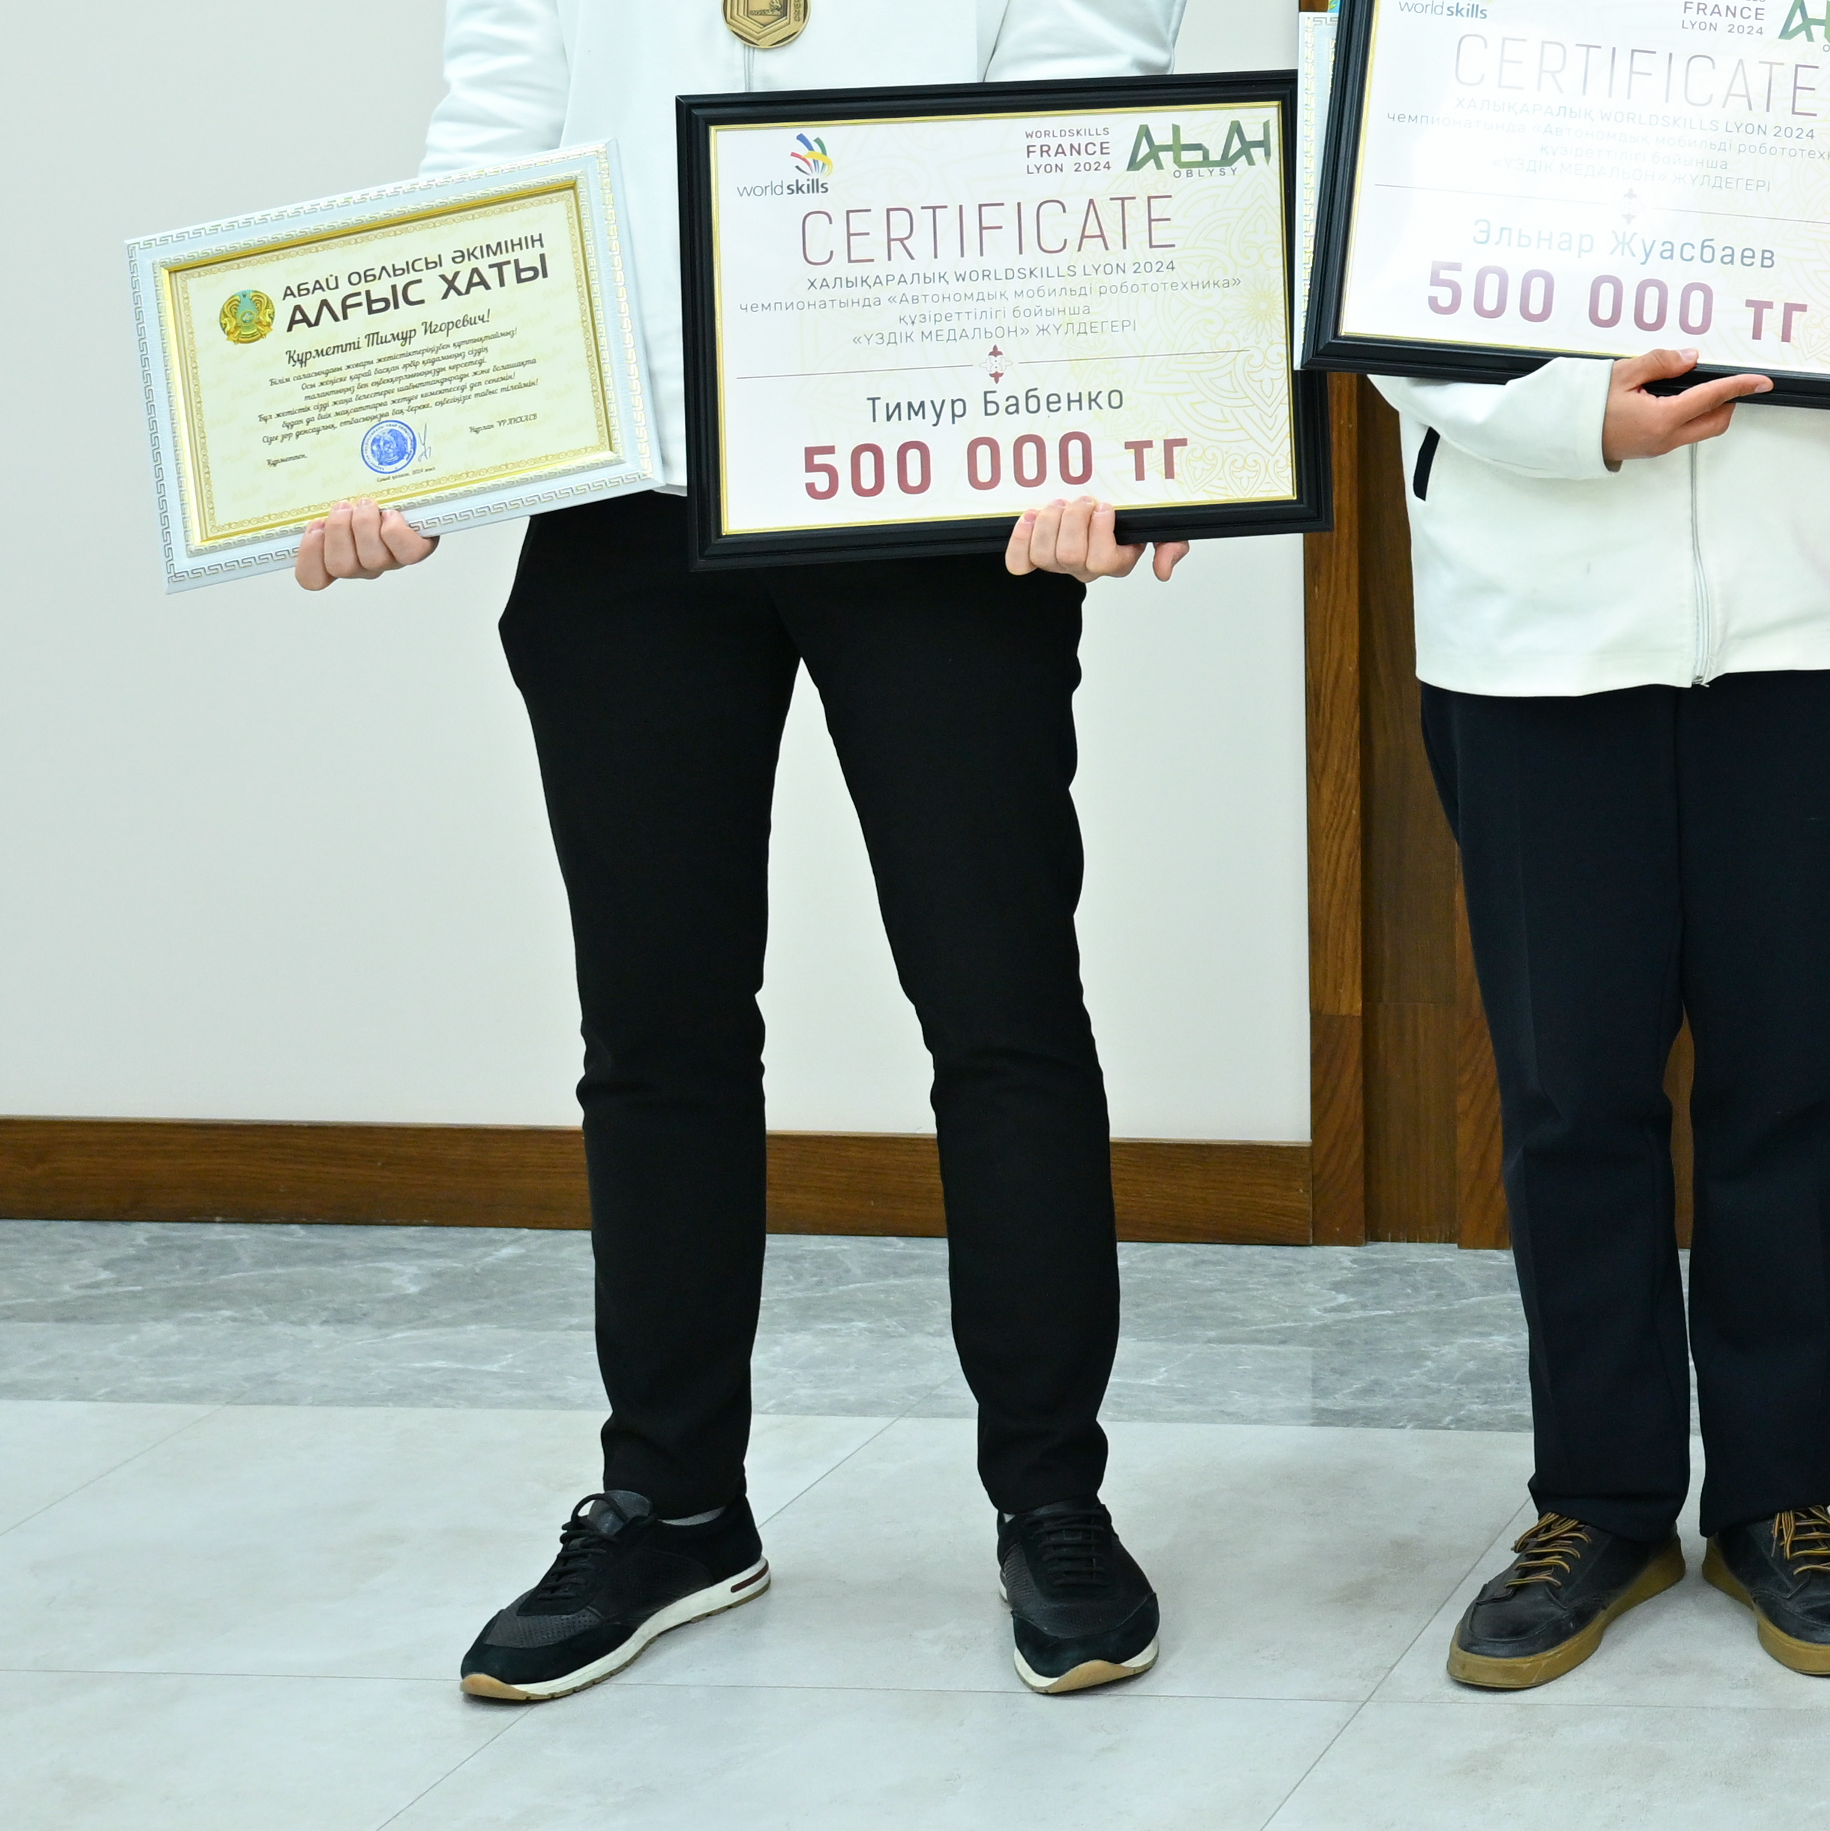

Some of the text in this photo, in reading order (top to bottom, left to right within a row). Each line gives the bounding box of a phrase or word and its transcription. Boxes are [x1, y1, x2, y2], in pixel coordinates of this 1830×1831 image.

[1397, 0, 1488, 20] worldskills
[1682, 0, 1765, 21] FRANCE
[1680, 18, 1764, 36] LYON 2024
[1454, 32, 1820, 117] CERTIFICATE
[1023, 125, 1110, 139] WORLDSKILLS
[1599, 108, 1719, 132] WORLDSKILLS
[1724, 120, 1767, 136] LYON
[1772, 124, 1815, 140] 2024
[1025, 140, 1111, 159] FRANCE
[1025, 159, 1112, 175] LYON 2024
[1171, 166, 1238, 179] OBLYSY
[735, 176, 829, 198] worldskills
[800, 193, 1176, 266] CERTIFICATE
[1471, 217, 1775, 269] Эльнар Жуасбаев
[281, 231, 545, 301] АБАЙ ОБЛЫСЫ ӘКІМІНІҢ
[806, 259, 1176, 291] ХАЛЫҚАРАЛЫҚ WORLDSKILLS LYON 2024
[285, 251, 549, 333] АЛҒЫС ХАТЫ
[738, 276, 1242, 313] чемпионатында «Автономдық мобильді робототехника»
[1426, 261, 1808, 344] 500 000 тг
[898, 303, 1091, 326] құзіреттілігі бойынша
[284, 307, 491, 369] Құрметті Тимур Игоревич!
[851, 318, 1136, 347] «ҮЗДІК МЕДАЛЬОН» ЖҮЛДЕГЕРІ
[865, 386, 1124, 427] Тимур Бабенко
[803, 430, 1188, 501] 500 000 тг
